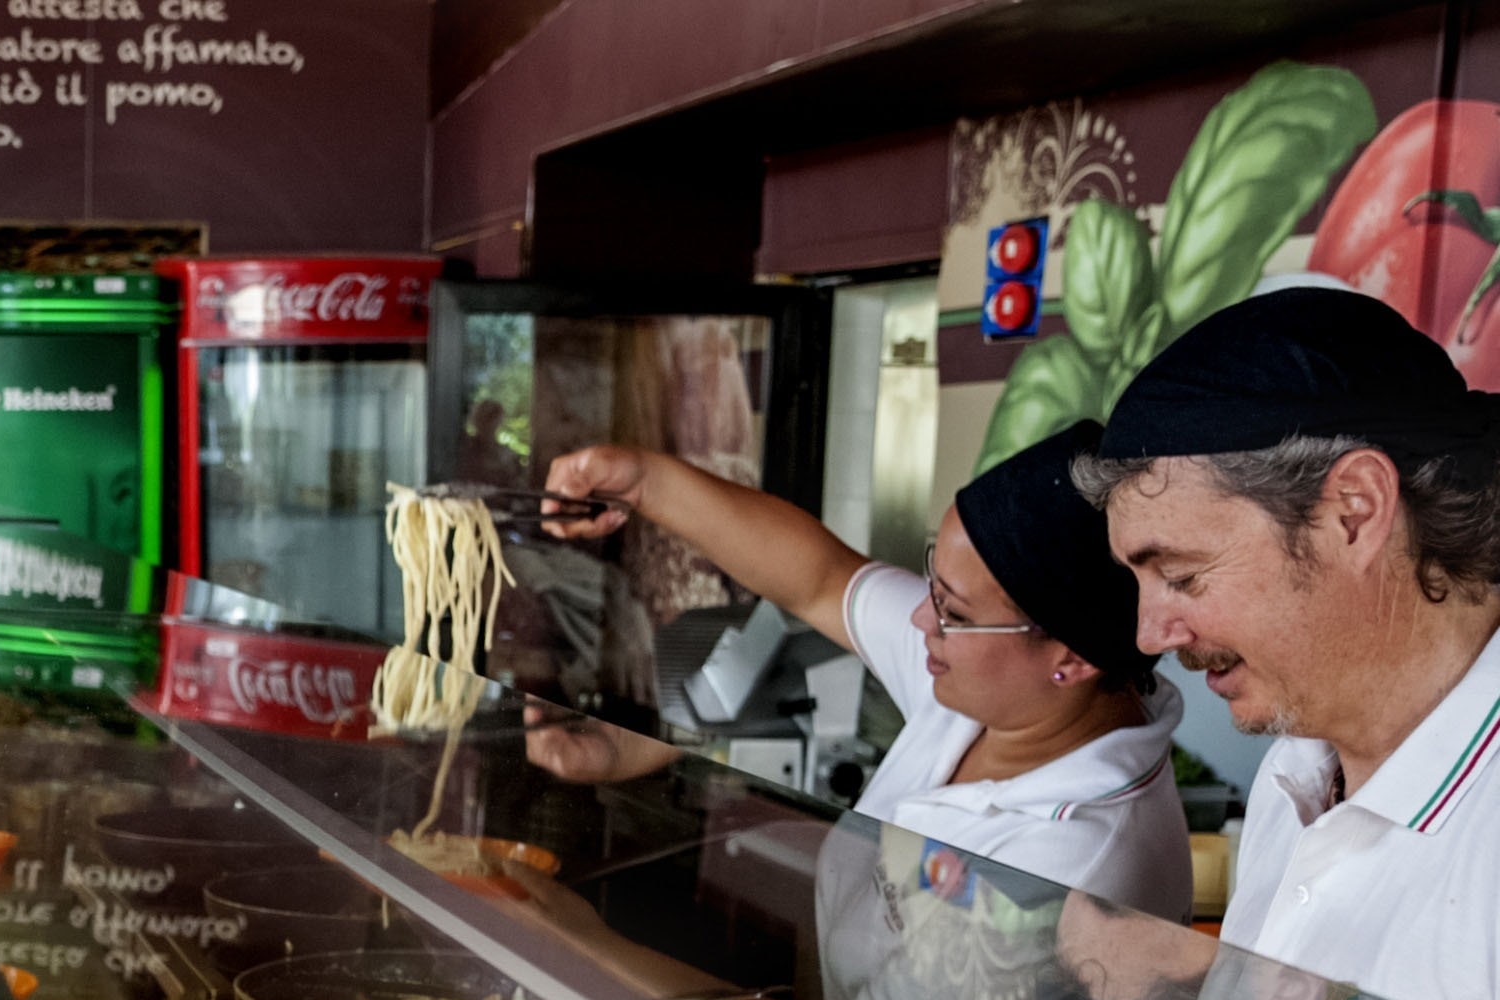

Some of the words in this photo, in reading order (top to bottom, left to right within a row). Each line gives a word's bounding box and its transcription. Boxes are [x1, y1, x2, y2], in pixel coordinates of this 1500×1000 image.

[117, 24, 305, 74] affamato,
[55, 73, 88, 106] il
[106, 80, 224, 125] pomo,
[3, 386, 114, 412] Heineken
